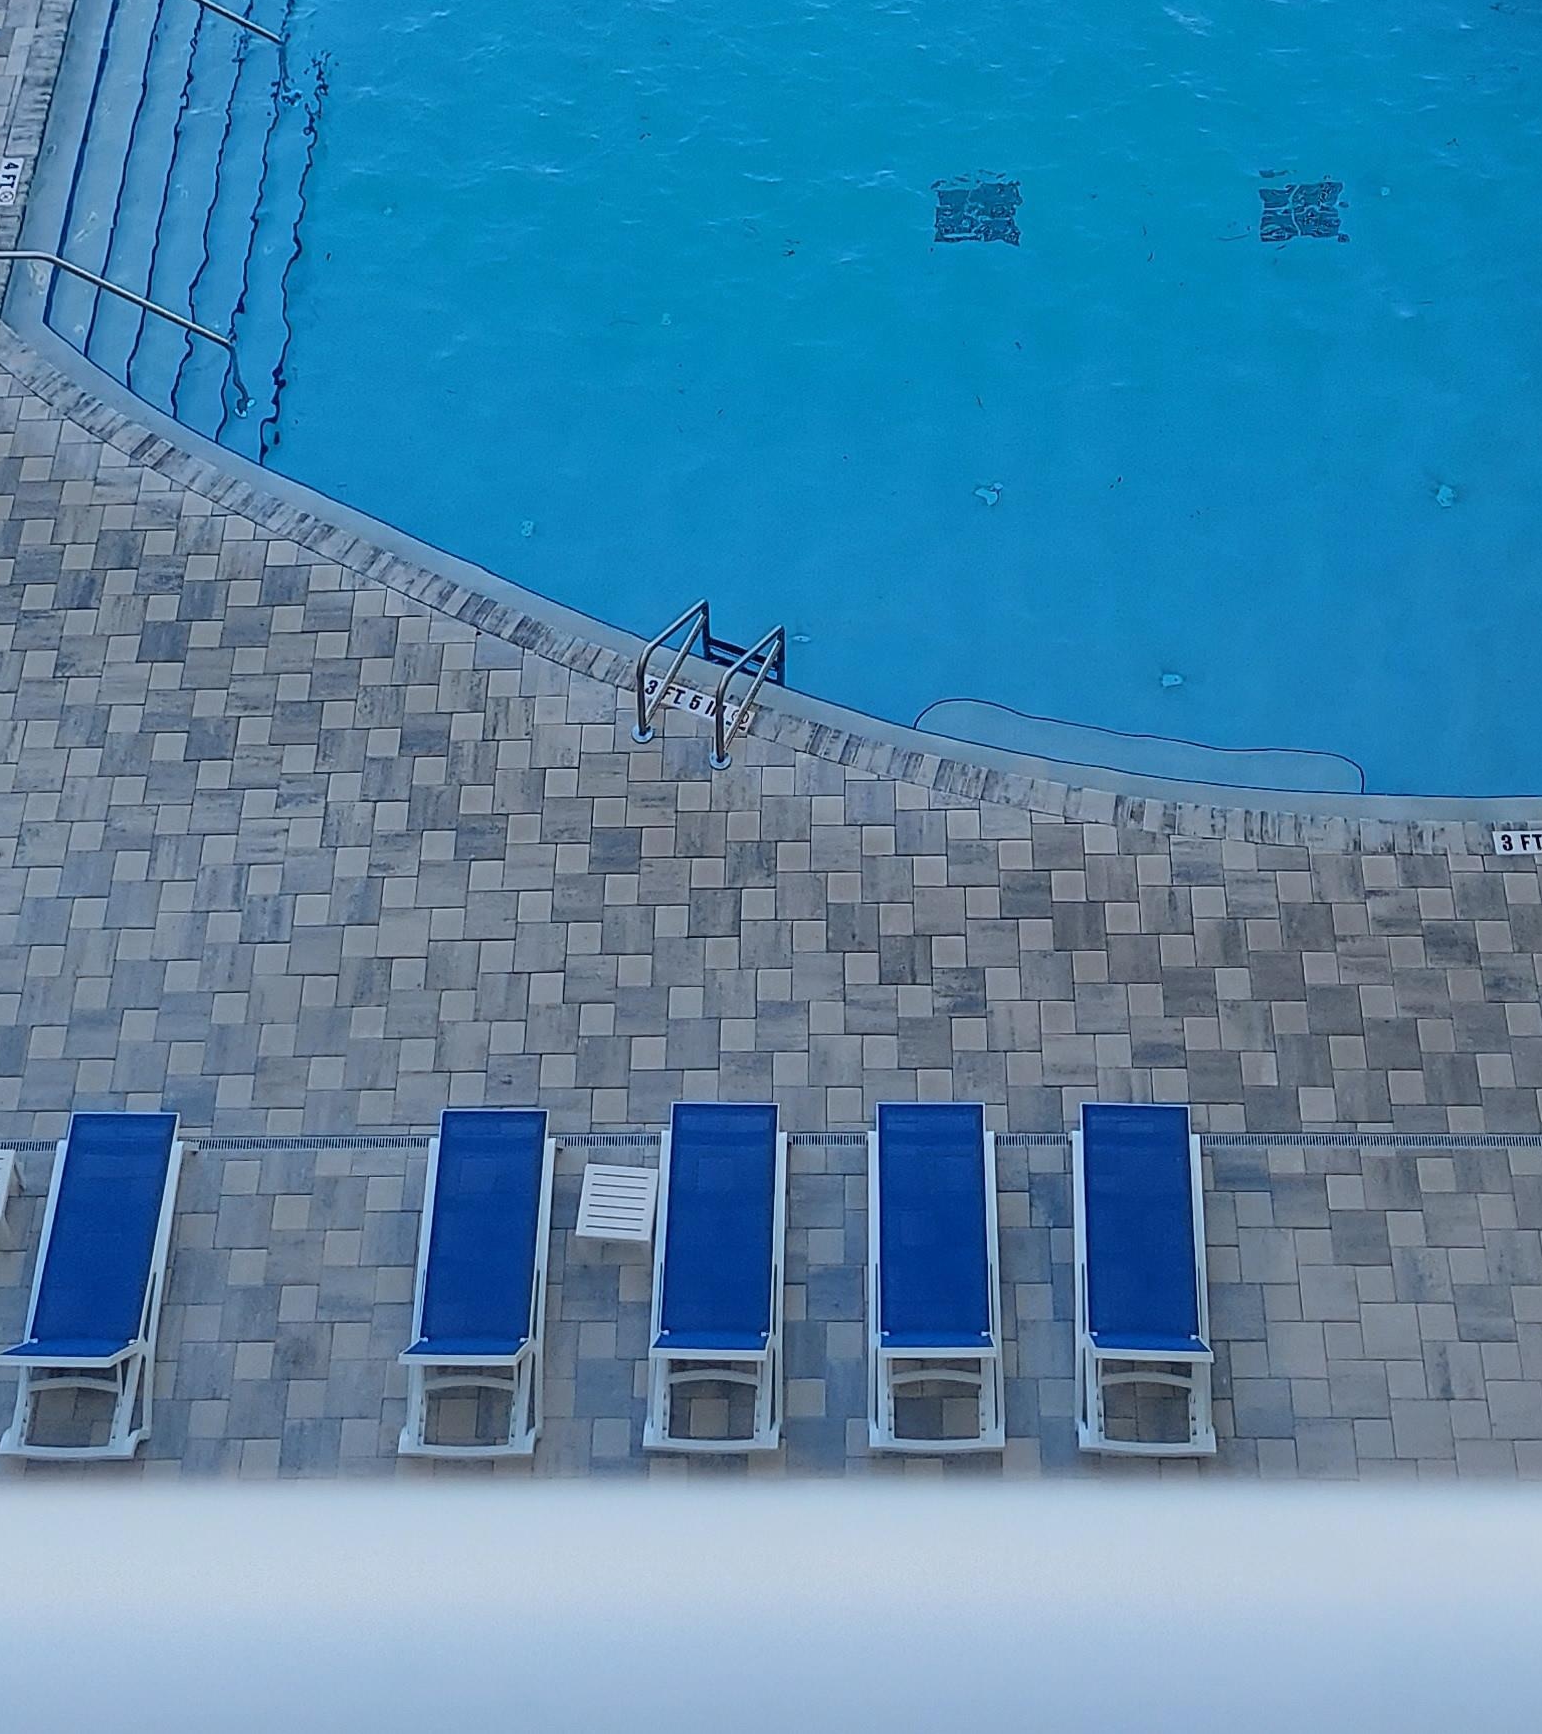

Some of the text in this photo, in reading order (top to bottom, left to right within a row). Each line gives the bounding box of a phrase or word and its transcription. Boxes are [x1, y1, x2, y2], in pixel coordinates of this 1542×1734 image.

[3, 161, 19, 170] 4
[644, 679, 659, 695] 3
[689, 694, 704, 711] 5
[1501, 834, 1514, 852] 3
